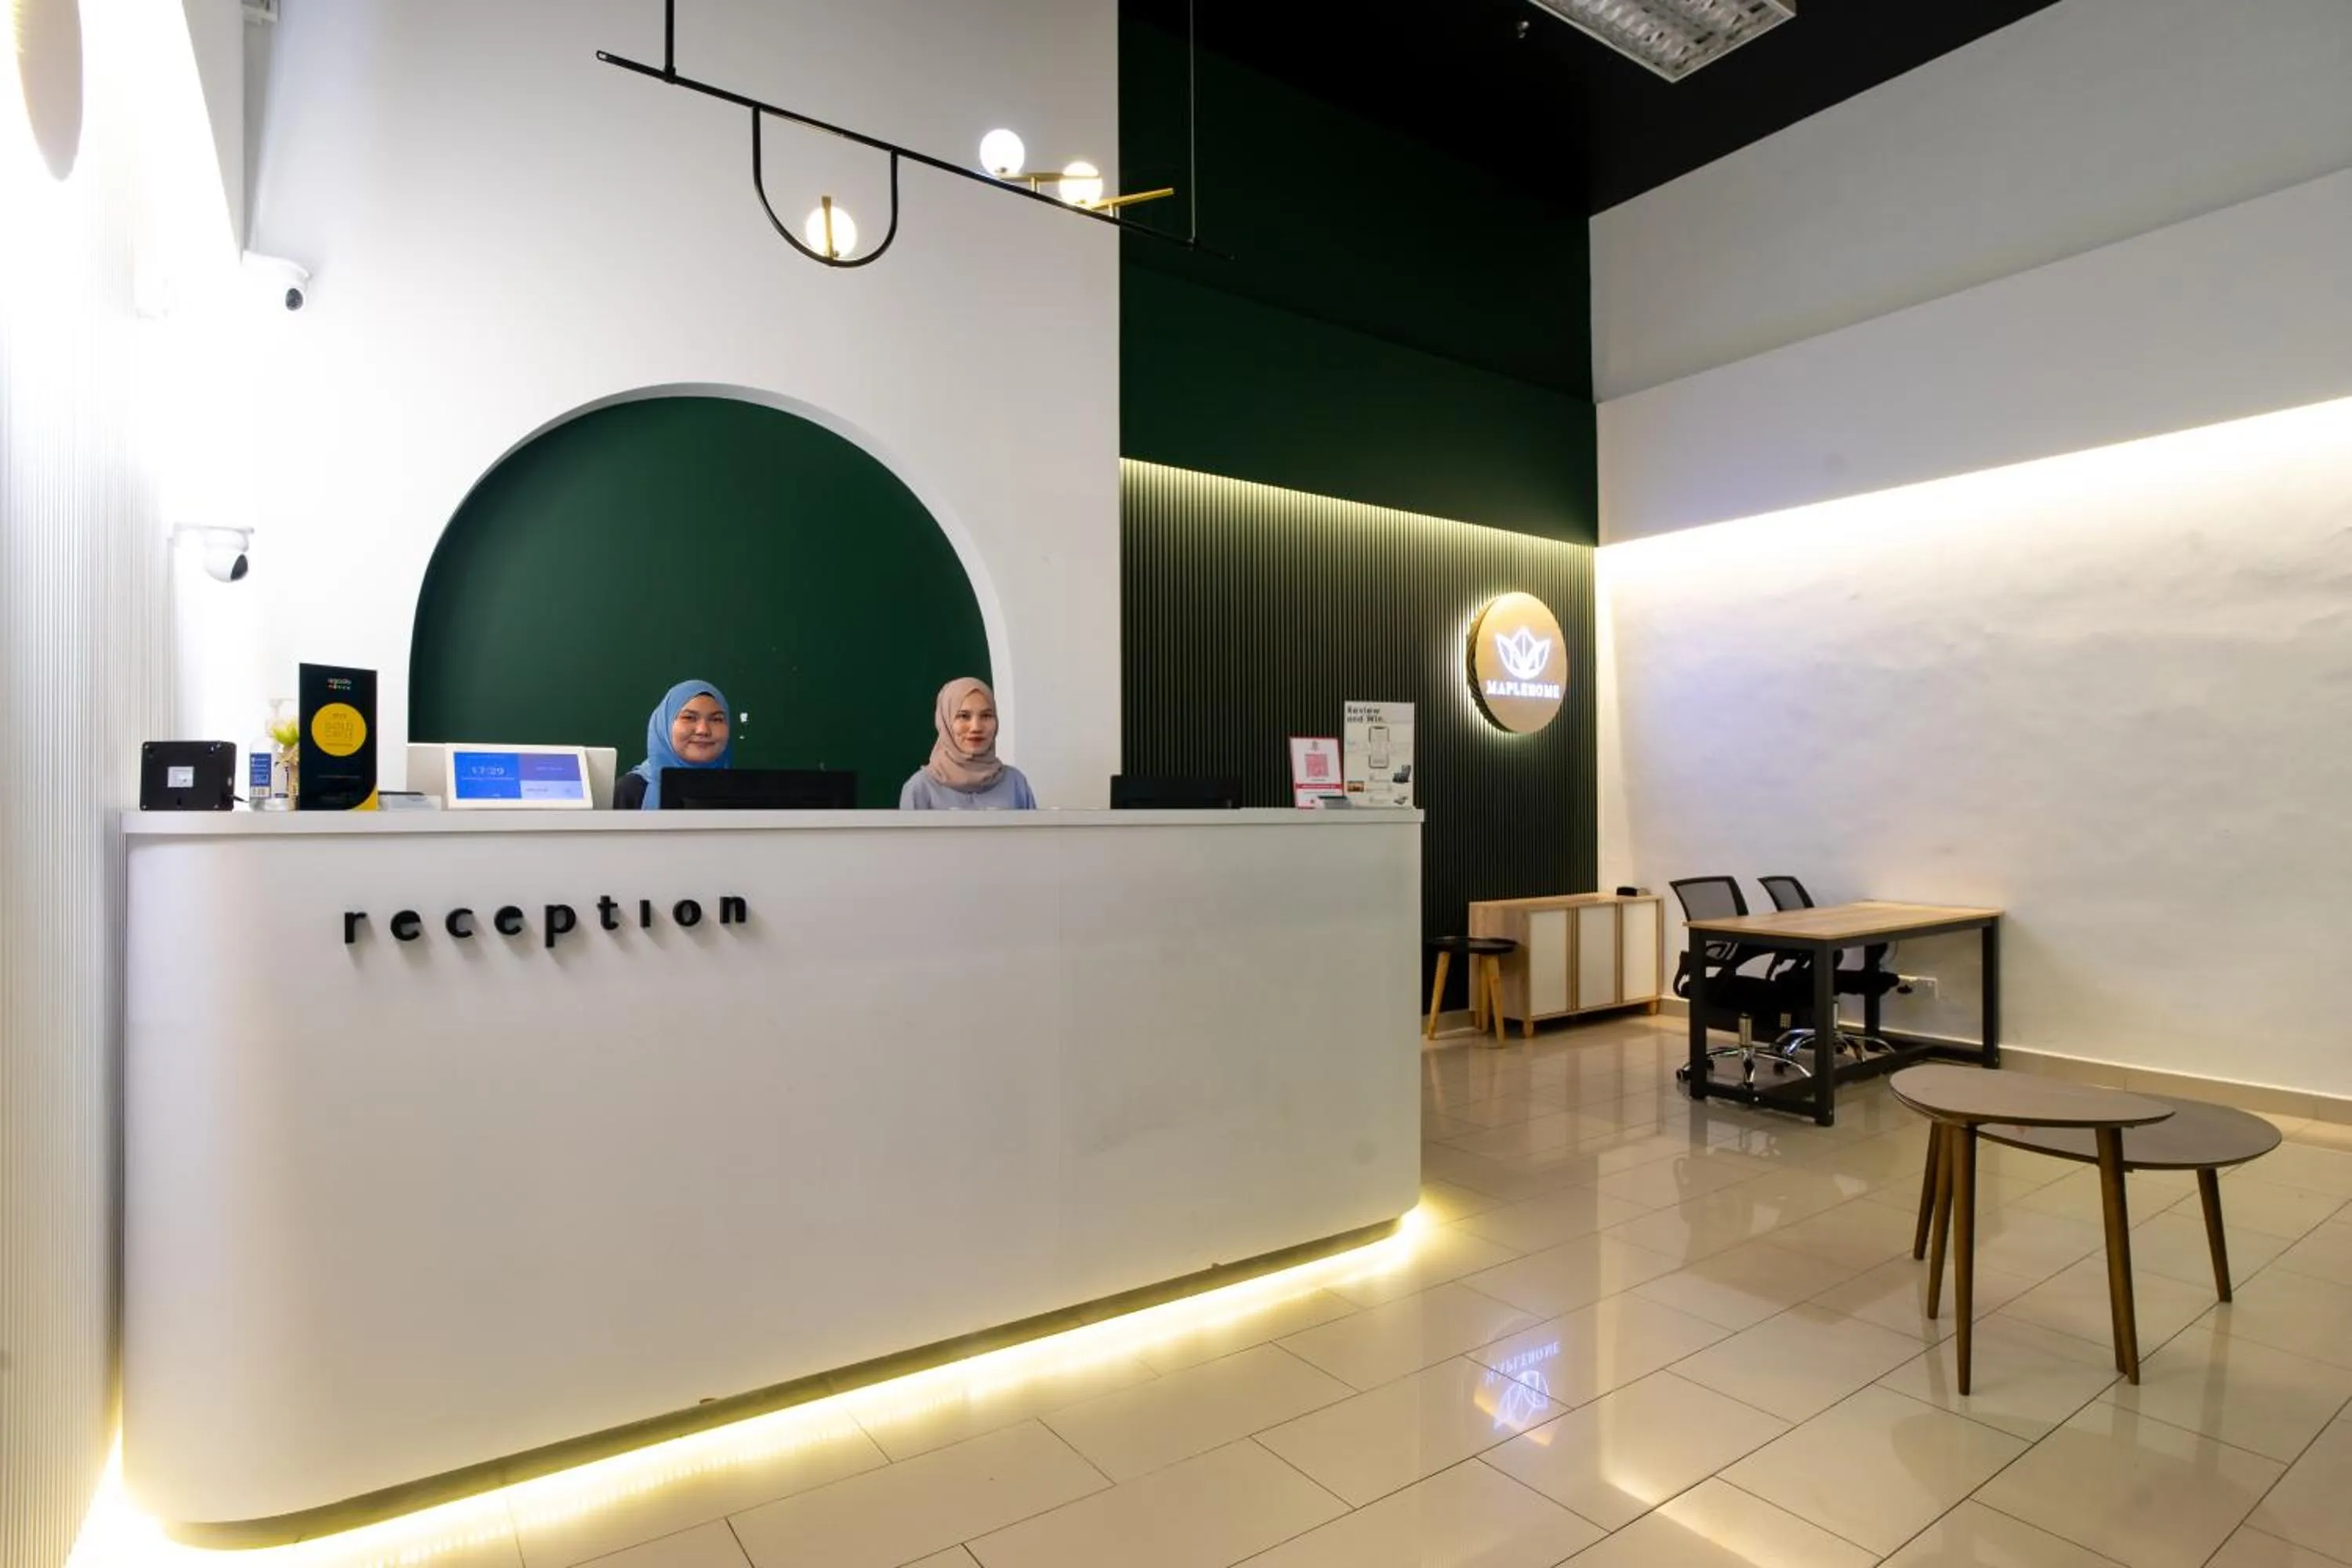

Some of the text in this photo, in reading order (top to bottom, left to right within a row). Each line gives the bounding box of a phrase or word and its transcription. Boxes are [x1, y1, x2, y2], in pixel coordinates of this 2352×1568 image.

[1486, 679, 1559, 699] MAPLEHOME
[1347, 706, 1381, 715] Review
[1346, 715, 1363, 724] and
[344, 895, 746, 948] reception
